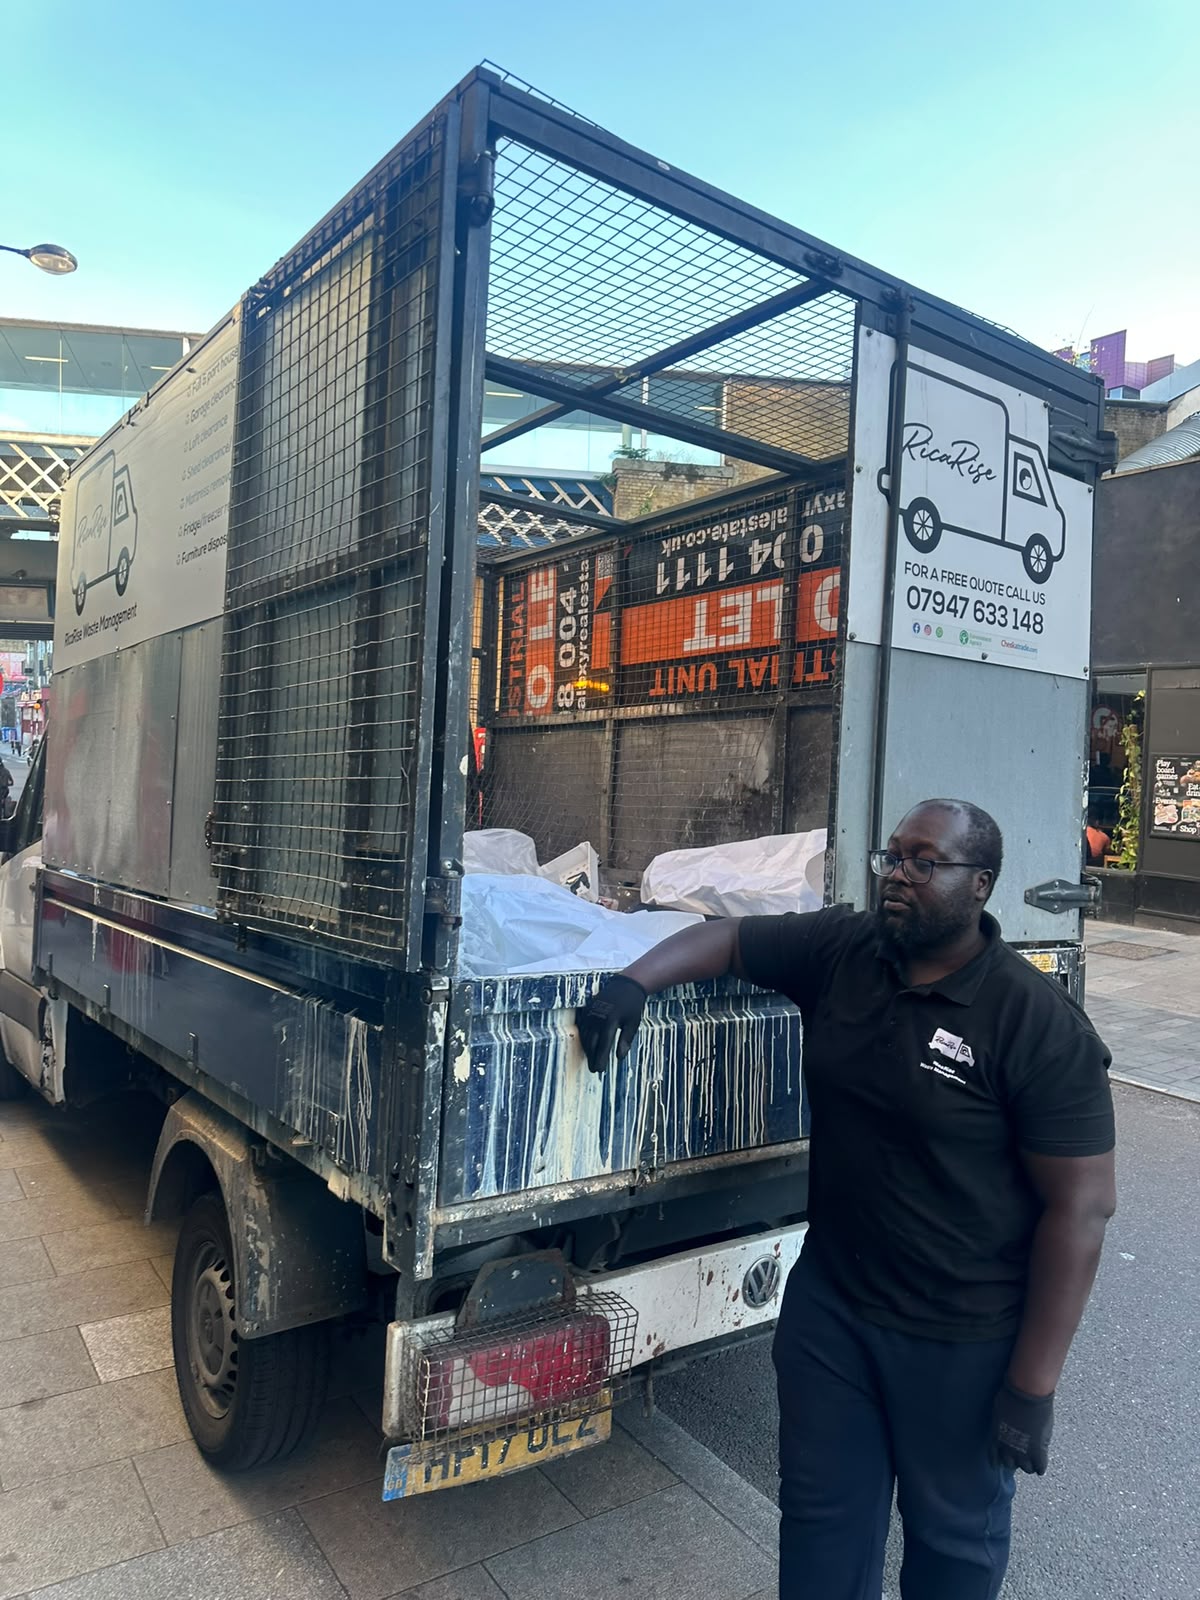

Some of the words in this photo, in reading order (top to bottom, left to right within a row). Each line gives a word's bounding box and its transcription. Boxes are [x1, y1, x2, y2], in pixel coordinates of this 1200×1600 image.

[901, 423, 997, 484] RicaRise
[656, 546, 735, 595] 1111
[904, 561, 929, 579] FOR
[929, 568, 940, 582] A
[940, 570, 968, 587] FREE
[969, 577, 1005, 597] QUOTE
[1005, 585, 1031, 602] CALL
[1032, 592, 1047, 606] US
[99, 602, 138, 632] Management
[906, 585, 970, 619] 07947
[973, 599, 1009, 628] 633
[1012, 607, 1045, 635] 148
[648, 661, 718, 697] UNIT
[1156, 759, 1171, 769] Play
[1180, 825, 1197, 835] Shop
